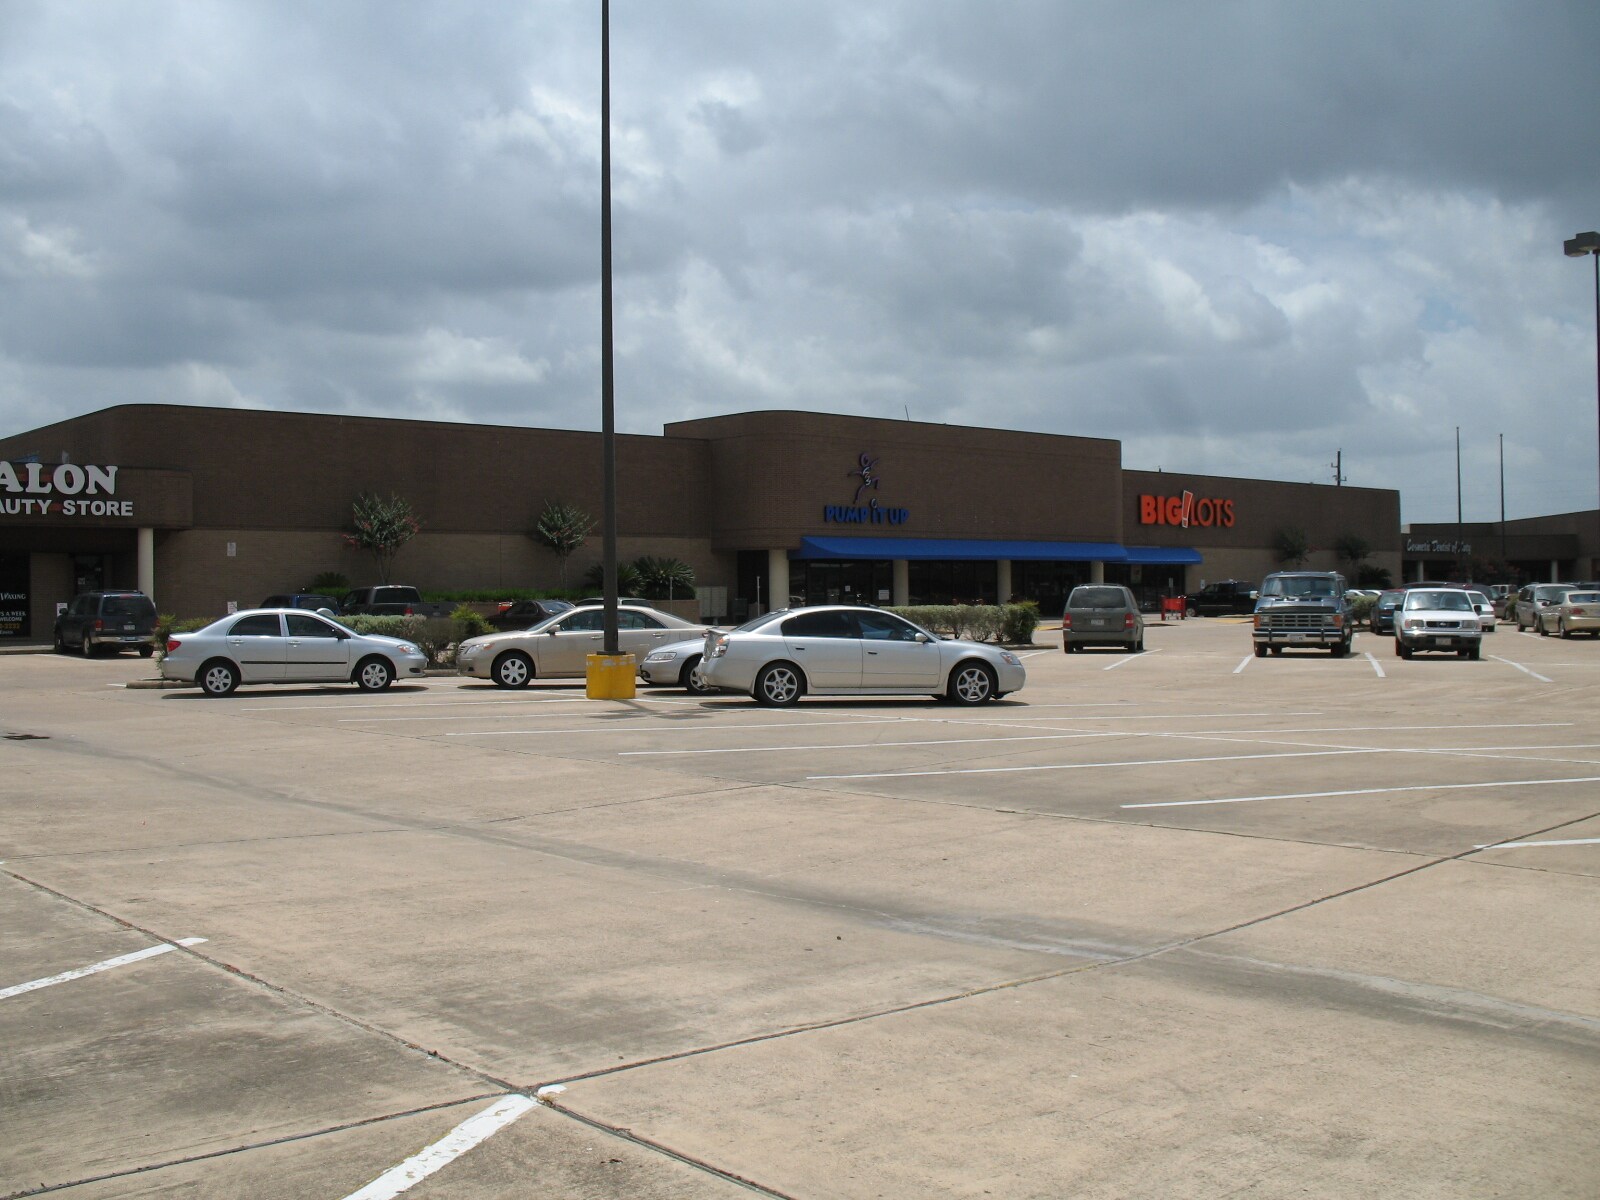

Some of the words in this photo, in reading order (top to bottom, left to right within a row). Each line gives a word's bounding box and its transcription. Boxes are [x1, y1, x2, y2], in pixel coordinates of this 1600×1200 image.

[0, 461, 119, 495] ALON
[62, 500, 134, 516] STORE
[825, 505, 869, 523] PUMP
[889, 507, 910, 525] UP
